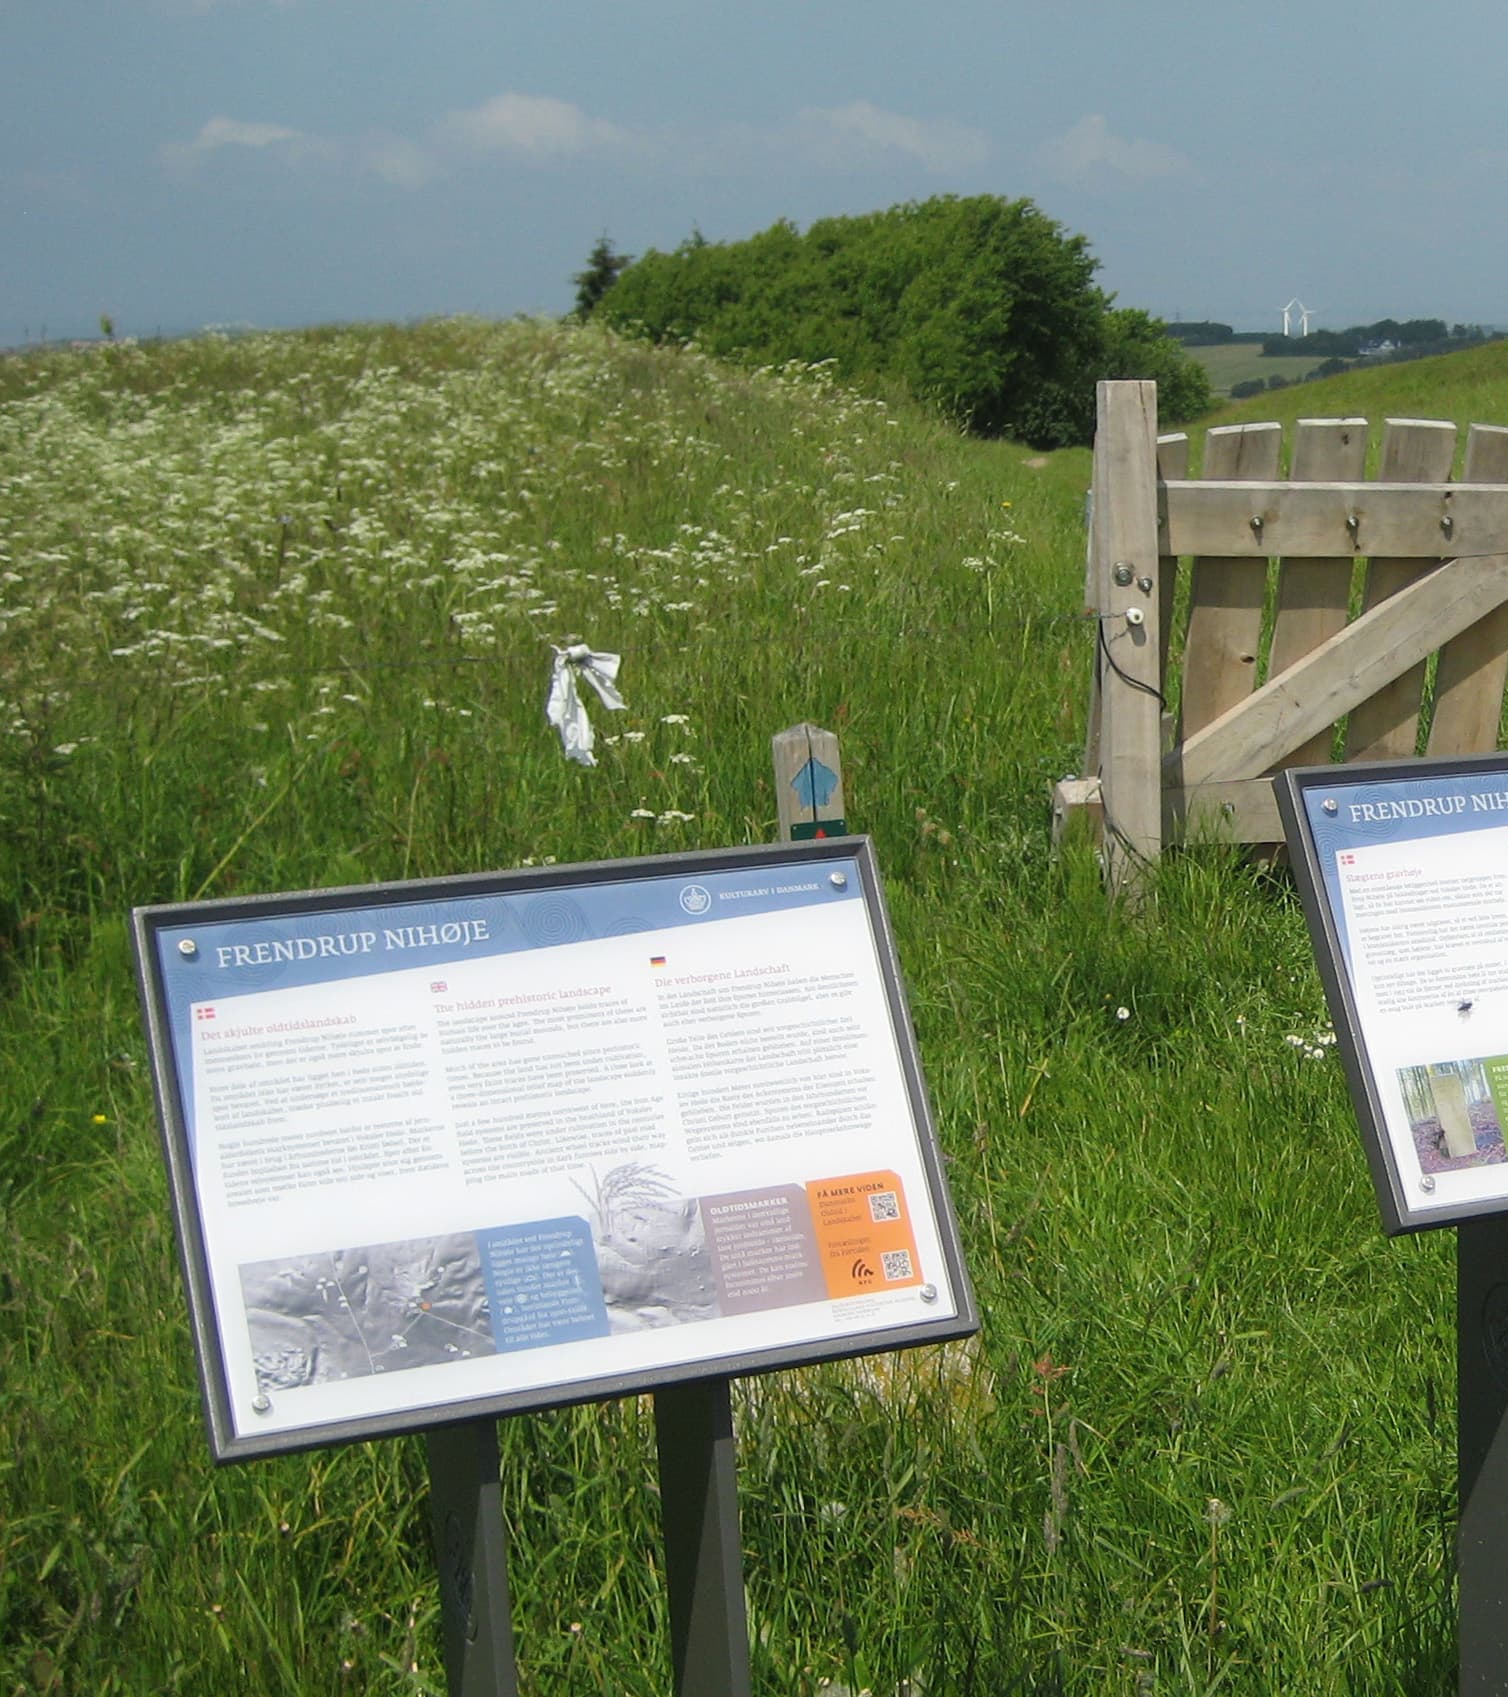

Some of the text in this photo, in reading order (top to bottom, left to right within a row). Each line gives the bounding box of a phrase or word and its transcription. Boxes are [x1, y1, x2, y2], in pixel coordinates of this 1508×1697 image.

[1348, 795, 1468, 823] FRENDRUP
[776, 882, 819, 893] DANMARK
[215, 917, 490, 969] FRENDRUP NIHØJE
[653, 963, 790, 988] Die verborgene Landschaft
[434, 983, 612, 1014] The hidden prehistoric landscape
[200, 1028, 221, 1041] Det
[222, 1024, 265, 1040] skjulte
[816, 1182, 884, 1198] FÅ MERE VIDEN
[709, 1196, 788, 1215] OLDTIDSMARKER
